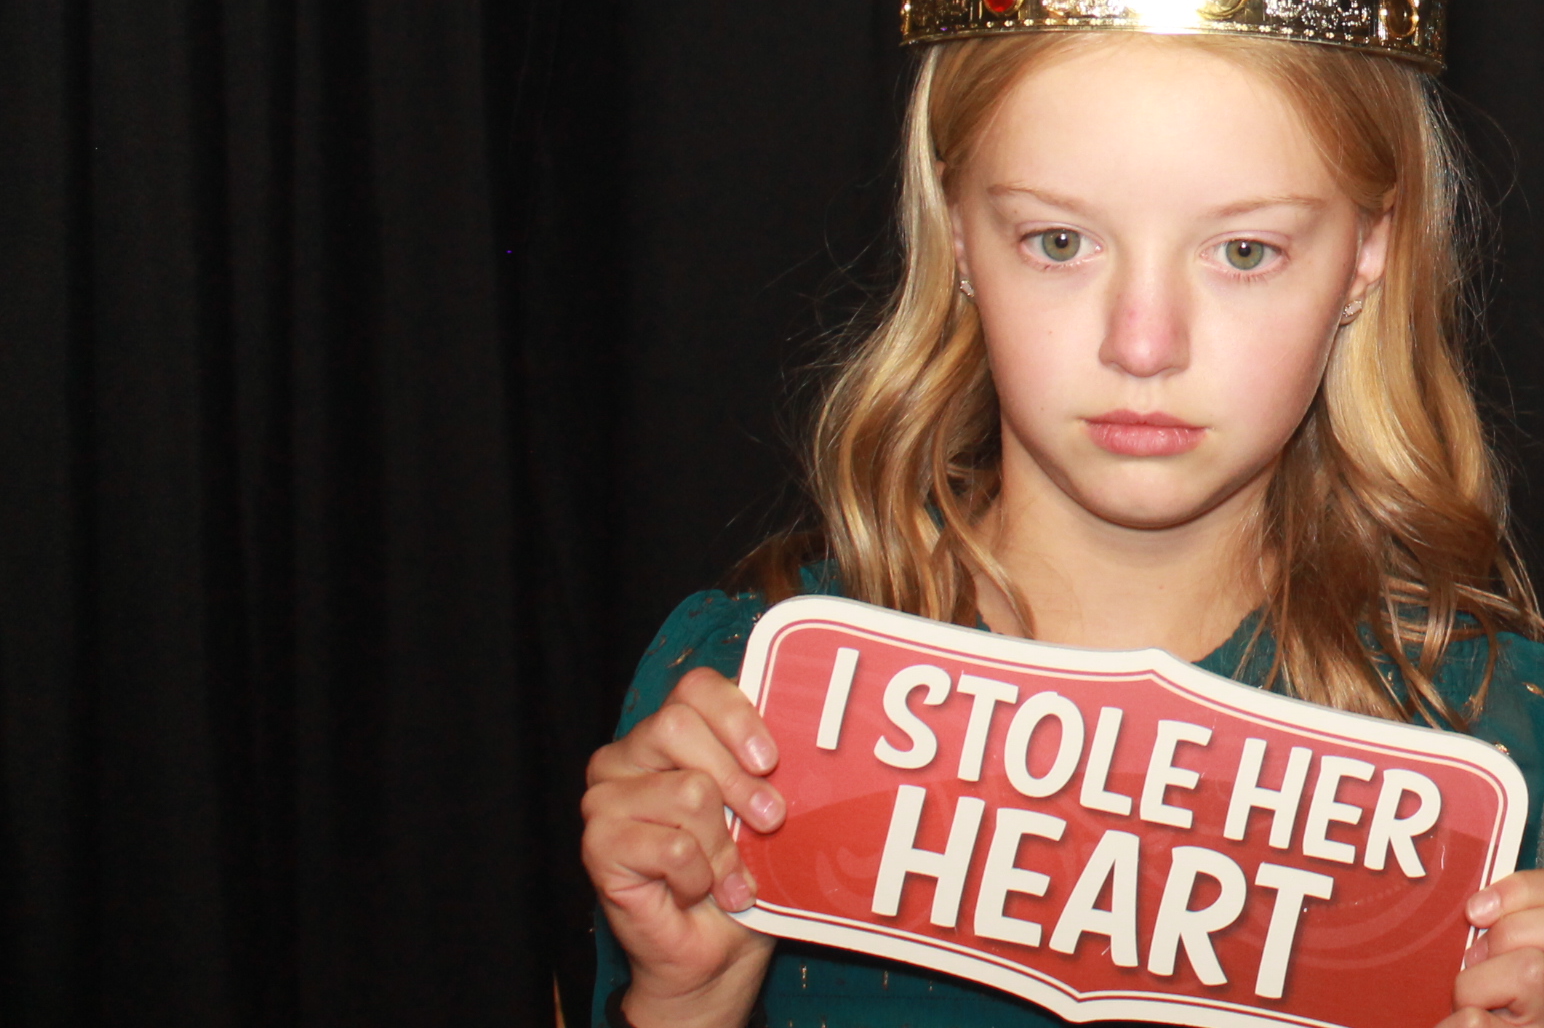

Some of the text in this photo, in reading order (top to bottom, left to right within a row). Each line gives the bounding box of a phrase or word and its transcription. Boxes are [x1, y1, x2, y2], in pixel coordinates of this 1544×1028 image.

[816, 647, 1442, 878] I STOLE HER
[871, 784, 1334, 999] HEART
